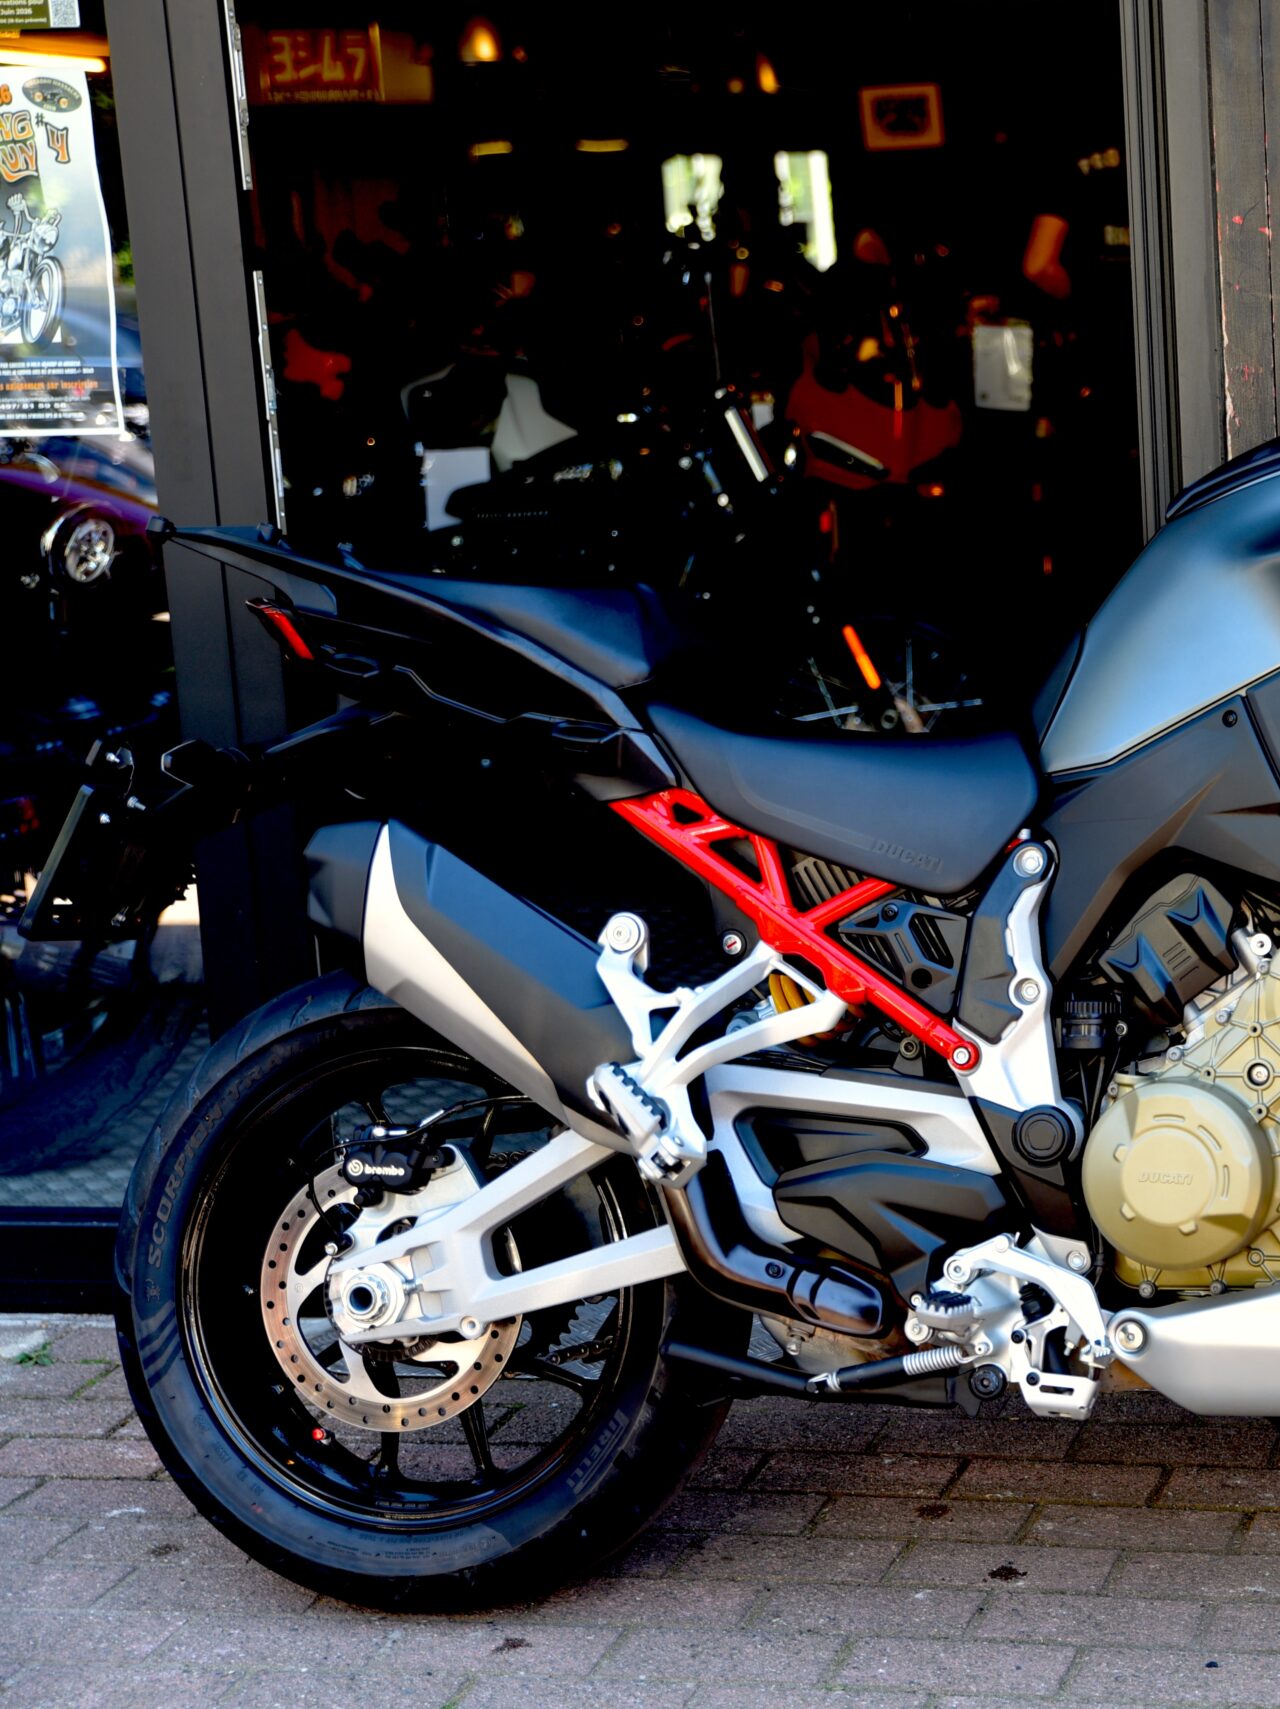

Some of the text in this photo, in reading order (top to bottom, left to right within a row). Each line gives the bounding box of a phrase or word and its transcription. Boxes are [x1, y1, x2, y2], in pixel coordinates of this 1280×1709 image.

[872, 840, 945, 875] DUCATI
[147, 1103, 224, 1269] SCORPION
[364, 1163, 405, 1176] brembo
[1137, 1170, 1193, 1186] DUCATI
[566, 1408, 629, 1495] PIRELLI
